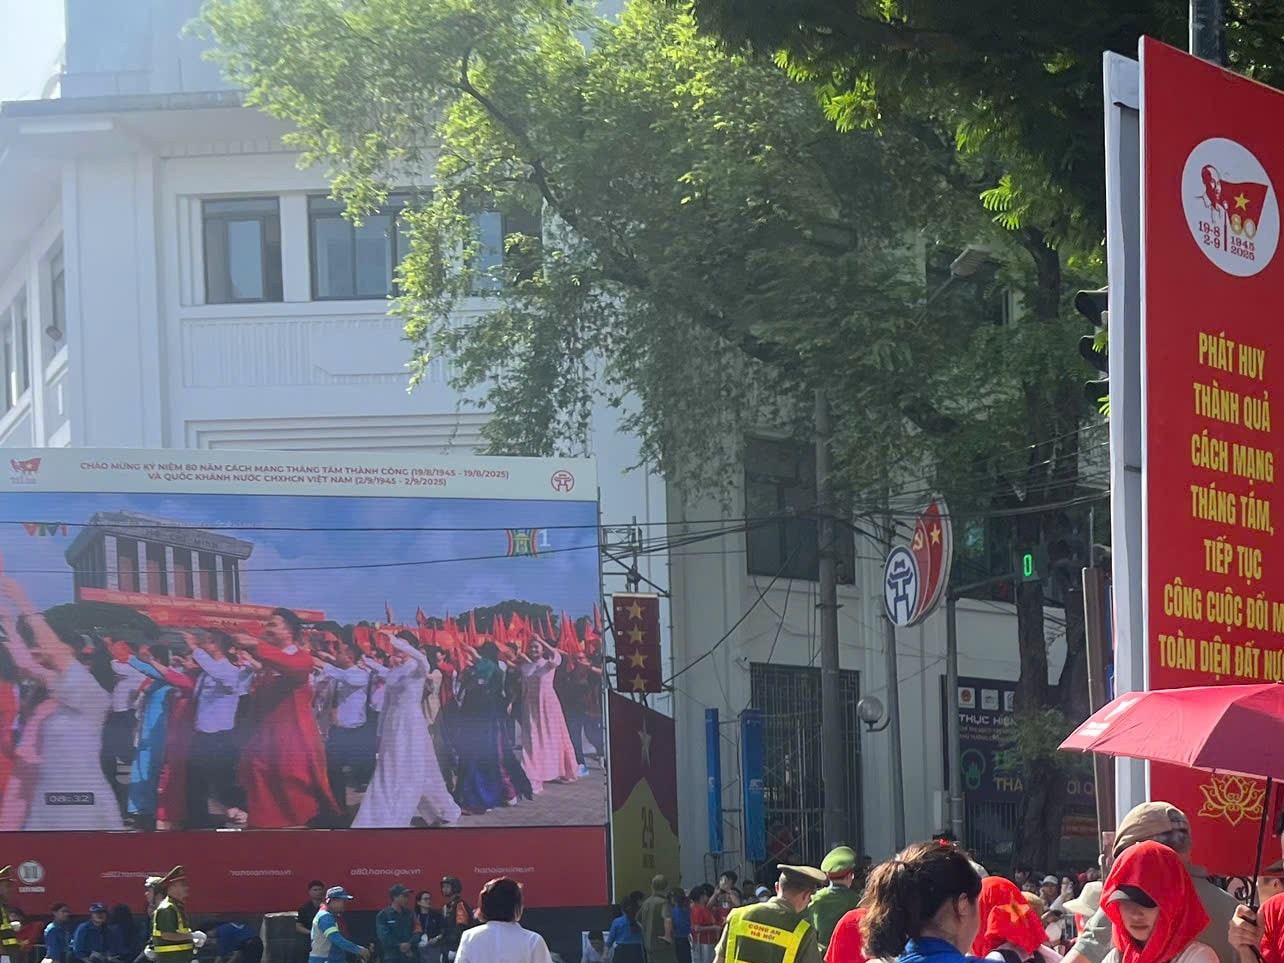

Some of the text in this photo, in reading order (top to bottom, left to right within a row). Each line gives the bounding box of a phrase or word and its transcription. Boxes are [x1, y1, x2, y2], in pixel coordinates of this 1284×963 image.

[1198, 220, 1220, 238] 19-8
[1231, 213, 1257, 240] 80
[1203, 234, 1220, 249] 2-9
[1230, 235, 1255, 252] 1945
[1230, 245, 1255, 261] 2025
[1199, 331, 1265, 381] PHÁT HUY
[1193, 379, 1271, 433] THÀNH QUẢ
[186, 463, 198, 472] 80
[286, 464, 320, 474] THÁNG
[322, 465, 343, 474] TÁM
[345, 465, 379, 475] THÀNH
[381, 466, 409, 476] CÔNG
[1191, 428, 1274, 486] CÁCH MẠNG
[148, 471, 162, 481] VÀ
[264, 474, 305, 483] CHXHCN
[307, 474, 328, 484] VIỆT
[330, 476, 353, 484] NAM
[355, 476, 396, 485] (2/9/1945
[404, 477, 447, 487] 2/9/2025)
[1190, 481, 1275, 536] THÁNG TÁM,
[1024, 554, 1032, 577] 0
[1204, 535, 1262, 585] TIẾP TỤC
[1164, 577, 1202, 621] CÔNG
[1207, 586, 1242, 632] CUỘC
[1246, 591, 1269, 631] ĐỔI
[1158, 629, 1196, 671] TOÀN
[1200, 635, 1231, 681] DIỆN
[1234, 640, 1260, 679] ĐẤT
